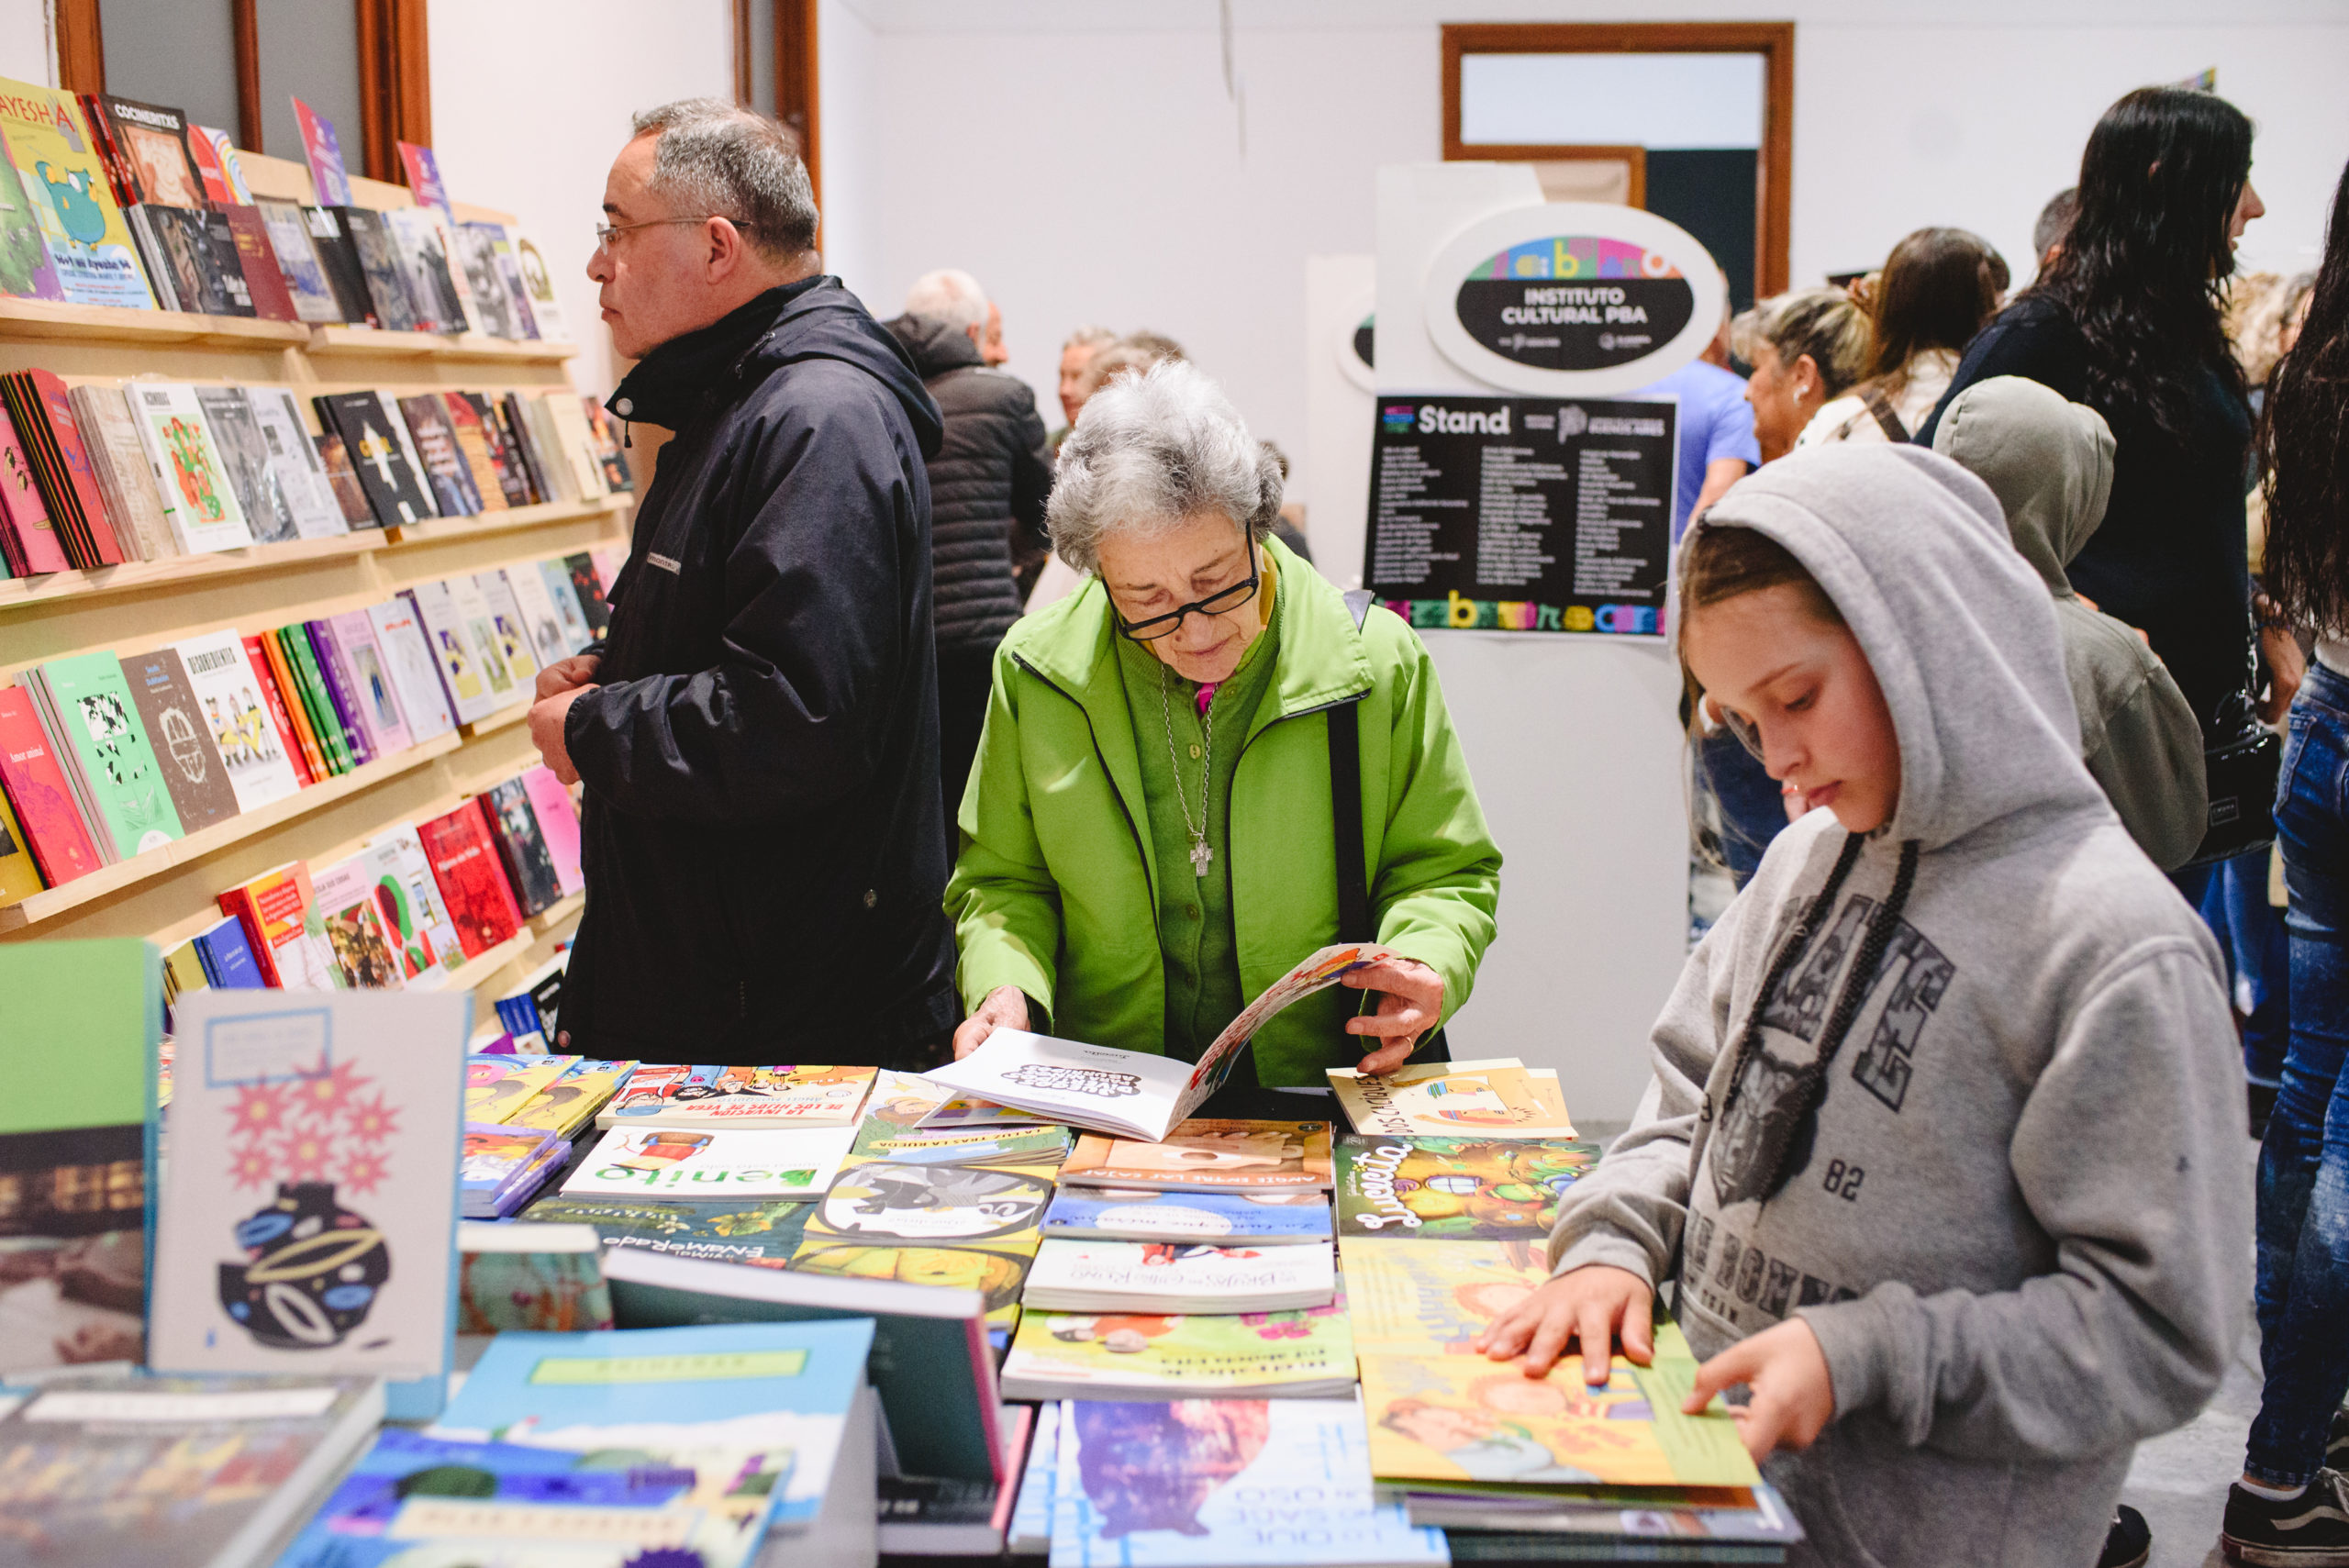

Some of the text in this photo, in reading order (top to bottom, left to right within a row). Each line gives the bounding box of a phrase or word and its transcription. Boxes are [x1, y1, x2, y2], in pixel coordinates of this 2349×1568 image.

[1523, 287, 1626, 306] INSTITUTO
[1500, 306, 1649, 325] CULTURAL PBA
[1418, 405, 1511, 435] Stand
[1376, 1117, 1415, 1134] DOS
[953, 1136, 986, 1144] TRAS
[595, 1167, 818, 1188] Benito
[1081, 1169, 1316, 1184] ANGIE ENTRE LAS CAJAS
[1351, 1143, 1423, 1229] Lucecita
[1822, 1158, 1865, 1203] 82
